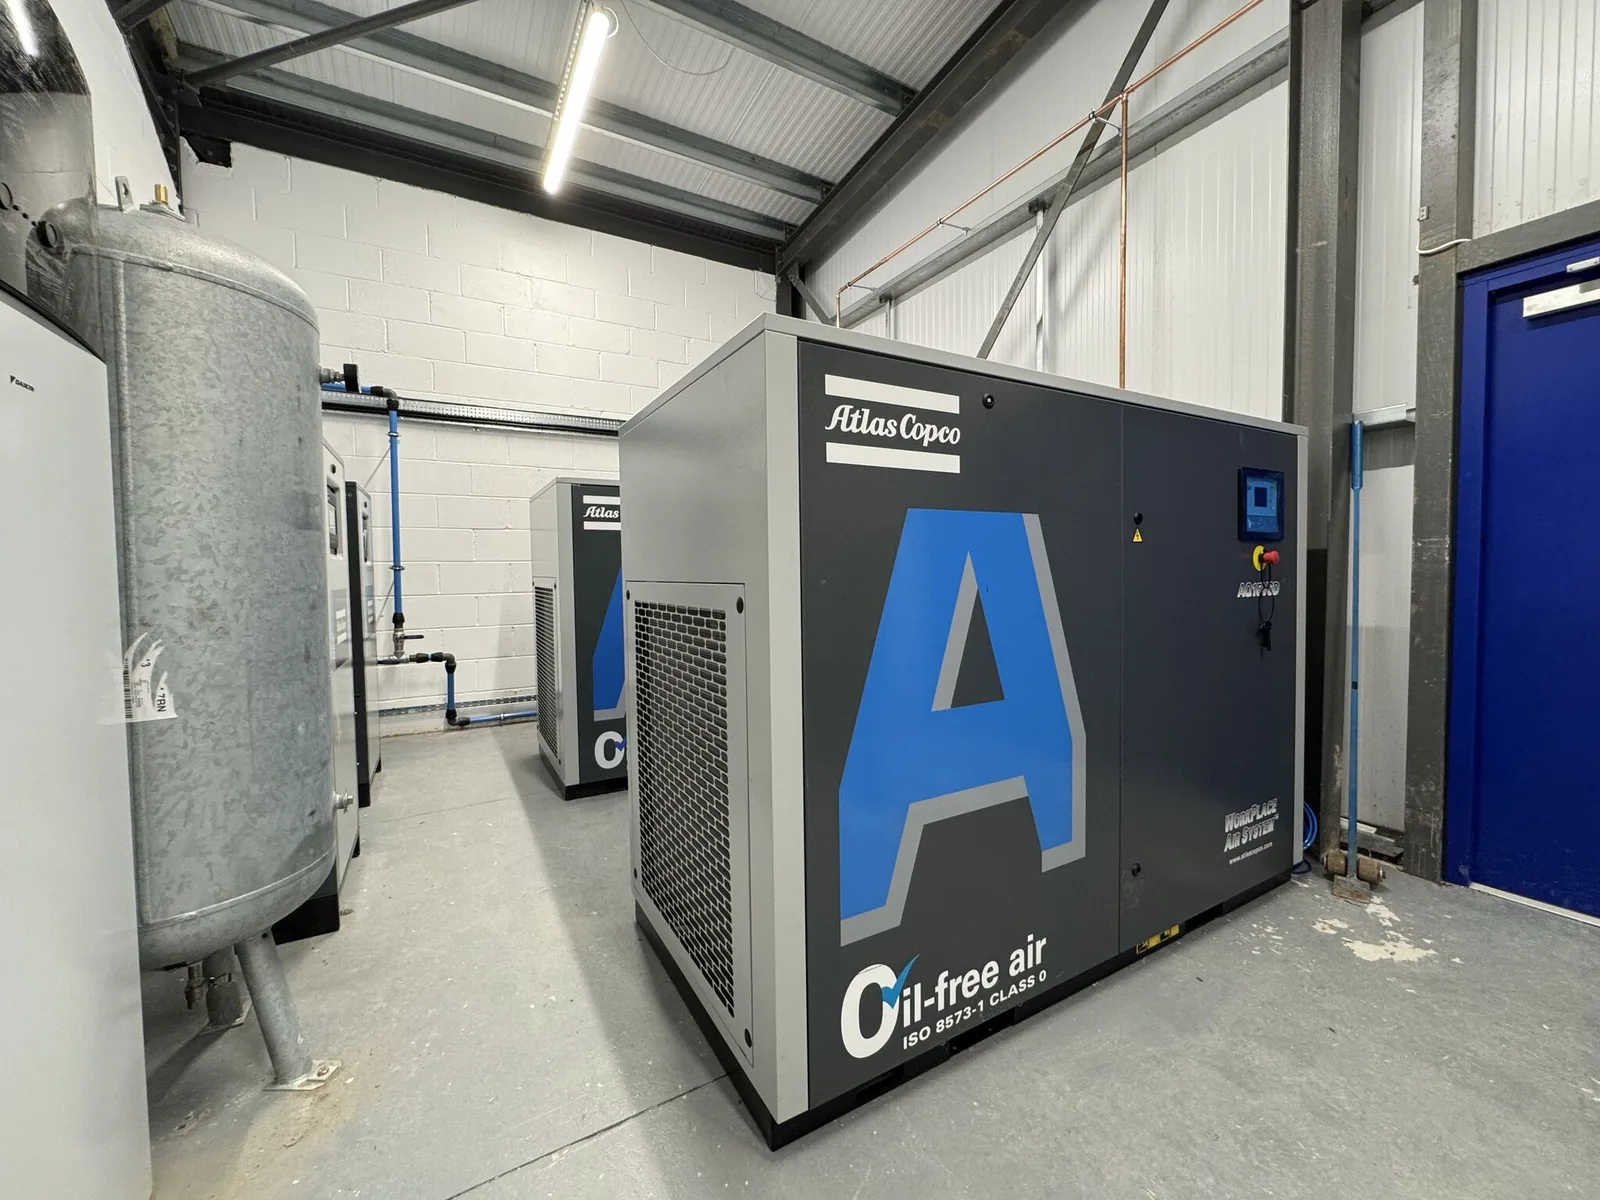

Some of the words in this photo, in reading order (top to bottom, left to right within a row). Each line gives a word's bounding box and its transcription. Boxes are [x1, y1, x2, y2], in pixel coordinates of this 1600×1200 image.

[825, 404, 898, 438] Atlas
[899, 413, 961, 447] Copco
[583, 505, 620, 519] Atlas
[840, 960, 1000, 1059] Oil-free
[1009, 933, 1047, 977] air
[902, 1025, 931, 1050] ISO
[935, 1000, 984, 1034] 8573-1
[989, 974, 1036, 1007] CLASS
